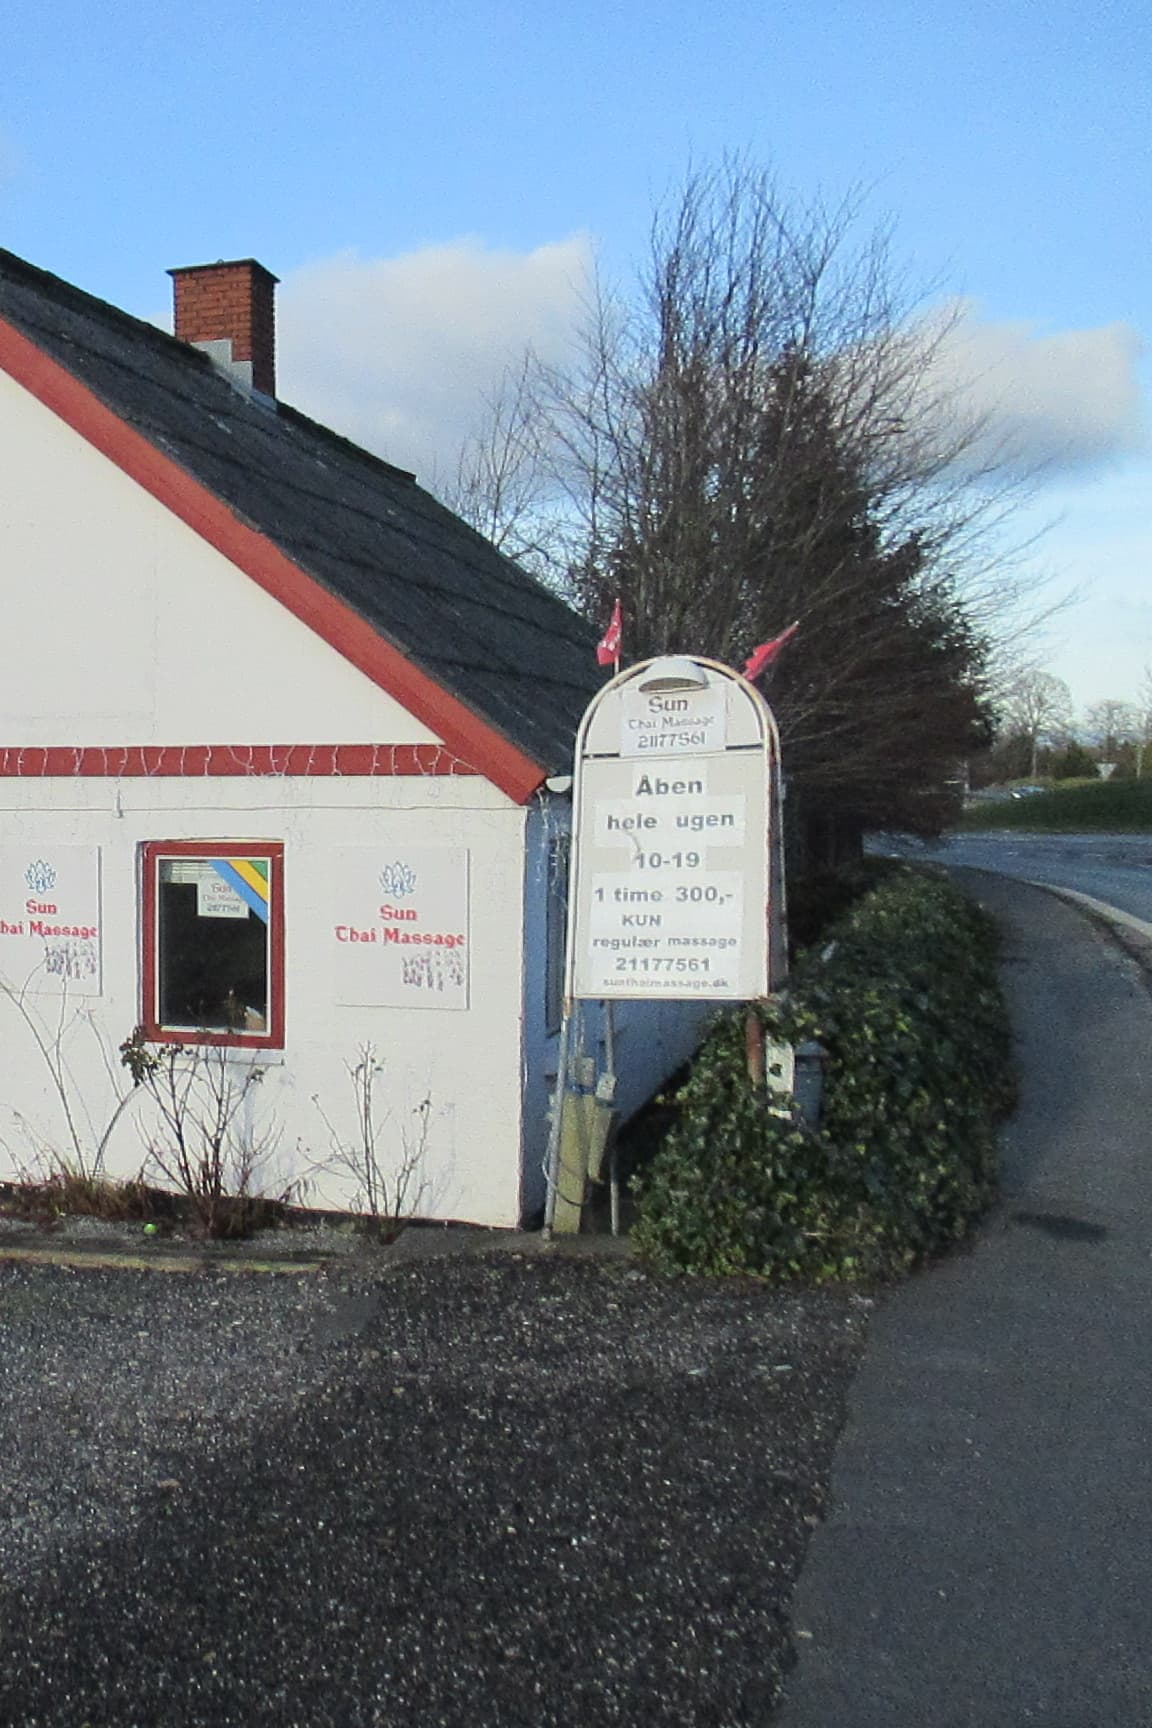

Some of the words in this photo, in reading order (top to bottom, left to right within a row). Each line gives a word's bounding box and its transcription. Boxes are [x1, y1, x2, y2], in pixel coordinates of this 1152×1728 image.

[648, 696, 688, 713] Sun
[637, 731, 706, 748] 21177561
[635, 774, 703, 796] Åben
[607, 814, 658, 831] hele
[676, 813, 735, 832] ugen
[635, 852, 700, 869] 10-19
[595, 887, 604, 902] 1
[614, 887, 663, 902] time
[675, 886, 733, 905] 300,-
[26, 899, 57, 915] Sun
[379, 905, 417, 920] Sun
[622, 914, 662, 926] KUN
[30, 921, 98, 939] Massage
[335, 926, 376, 942] Thai
[383, 928, 465, 948] Massage
[592, 935, 661, 951] regulær
[667, 936, 737, 950] massage
[615, 957, 711, 972] 21177561
